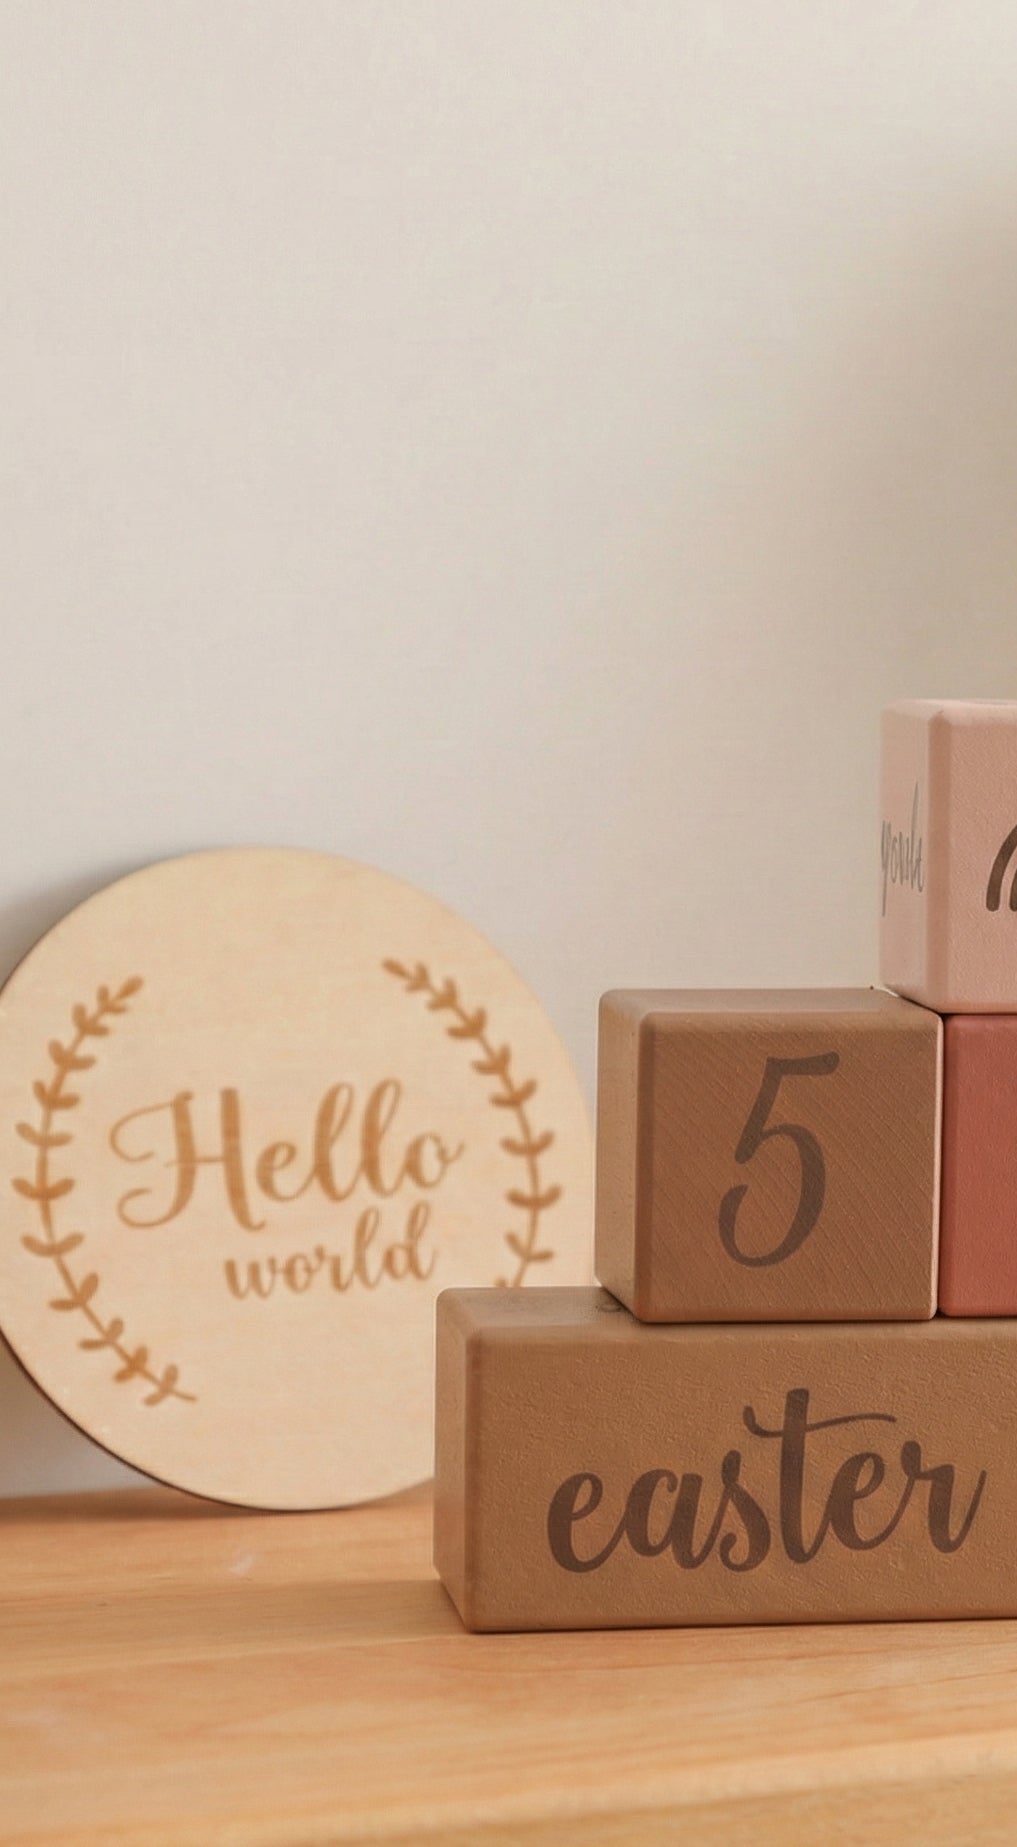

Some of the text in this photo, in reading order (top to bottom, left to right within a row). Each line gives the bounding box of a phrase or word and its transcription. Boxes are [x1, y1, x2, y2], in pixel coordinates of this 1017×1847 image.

[109, 1079, 464, 1231] Hello
[718, 1051, 840, 1267] 5
[224, 1202, 437, 1299] world
[547, 1389, 986, 1573] easter
